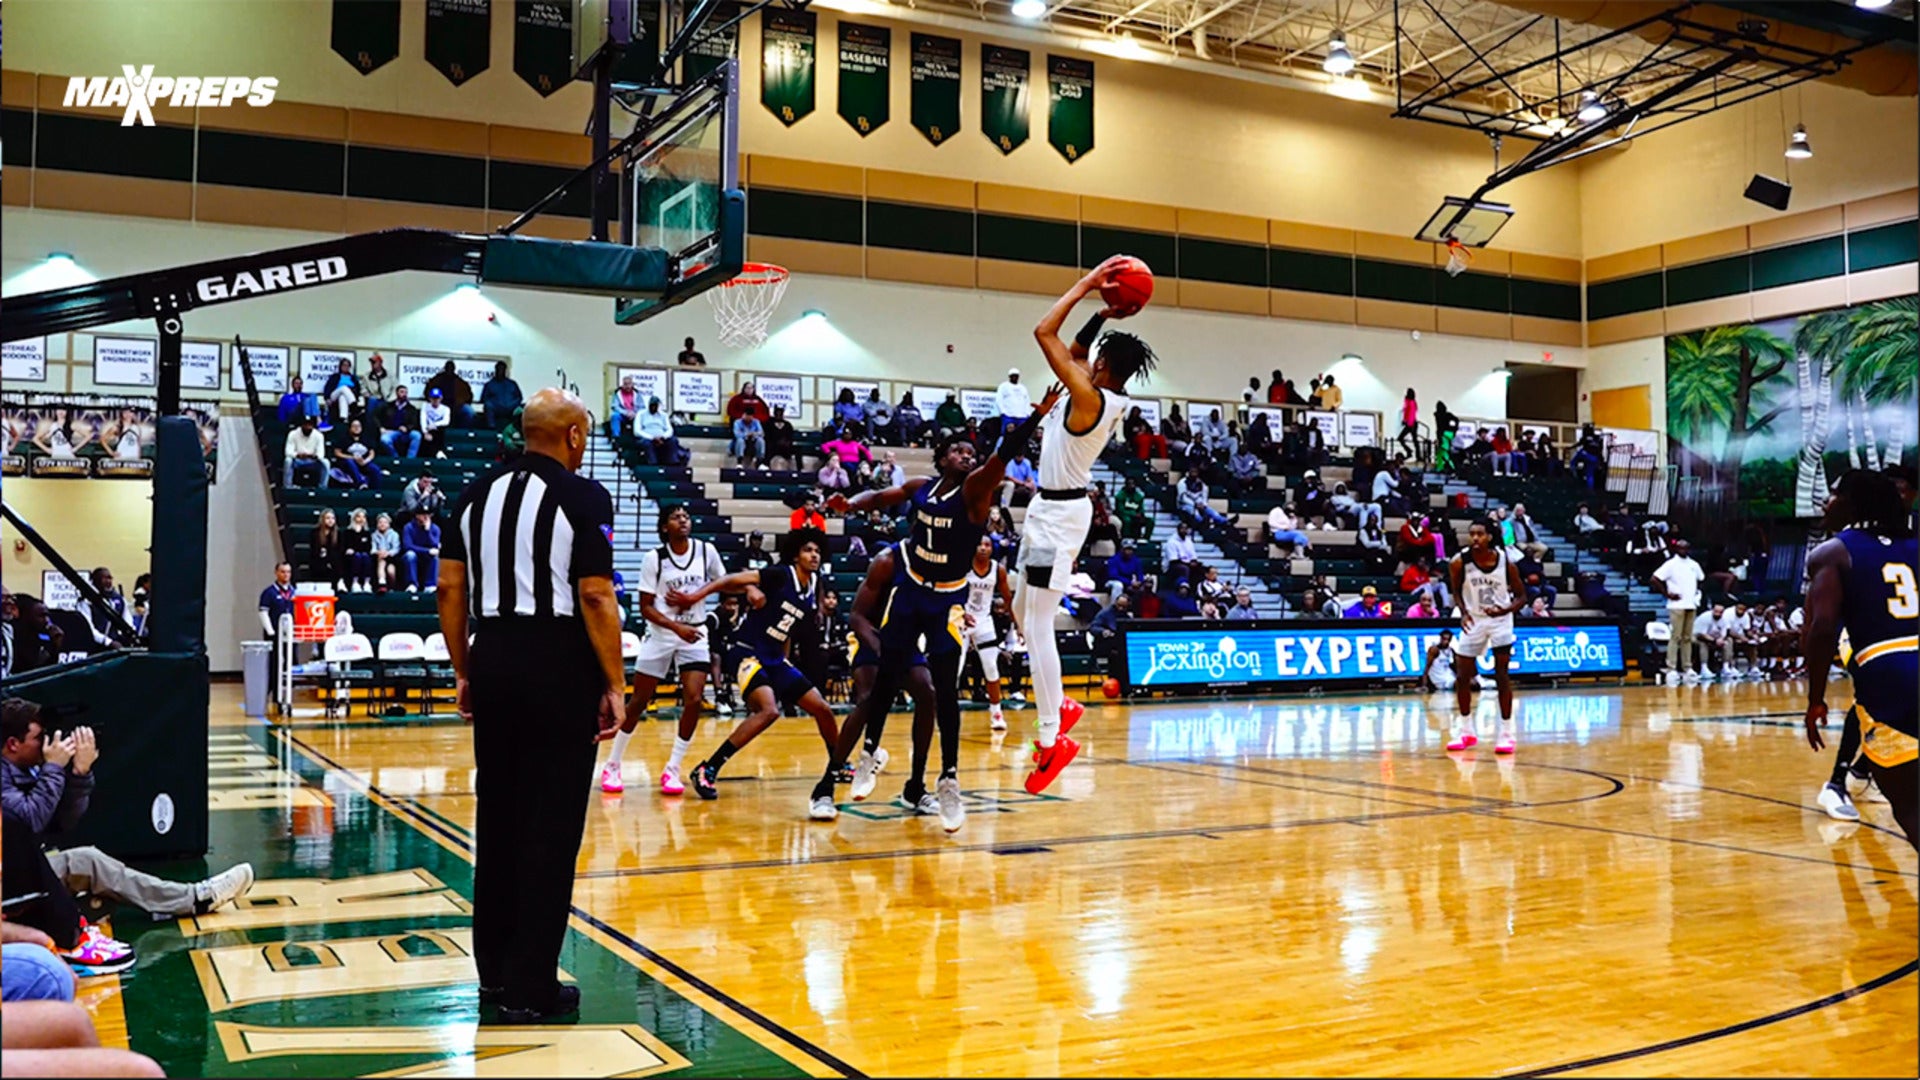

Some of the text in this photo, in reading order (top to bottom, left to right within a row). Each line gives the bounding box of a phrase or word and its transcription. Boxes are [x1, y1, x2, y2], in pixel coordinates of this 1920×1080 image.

[840, 51, 888, 67] BASEBALL
[197, 256, 348, 302] GARED
[102, 355, 148, 364] ENGINEERING
[761, 383, 795, 392] SECURITY
[763, 392, 792, 402] FEDERAL
[934, 517, 953, 528] CITY
[1881, 562, 1919, 619] 3
[1528, 637, 1553, 645] TOWN
[1157, 643, 1189, 651] TOWN
[1523, 634, 1609, 668] Lexington
[1142, 638, 1261, 683] Lexington
